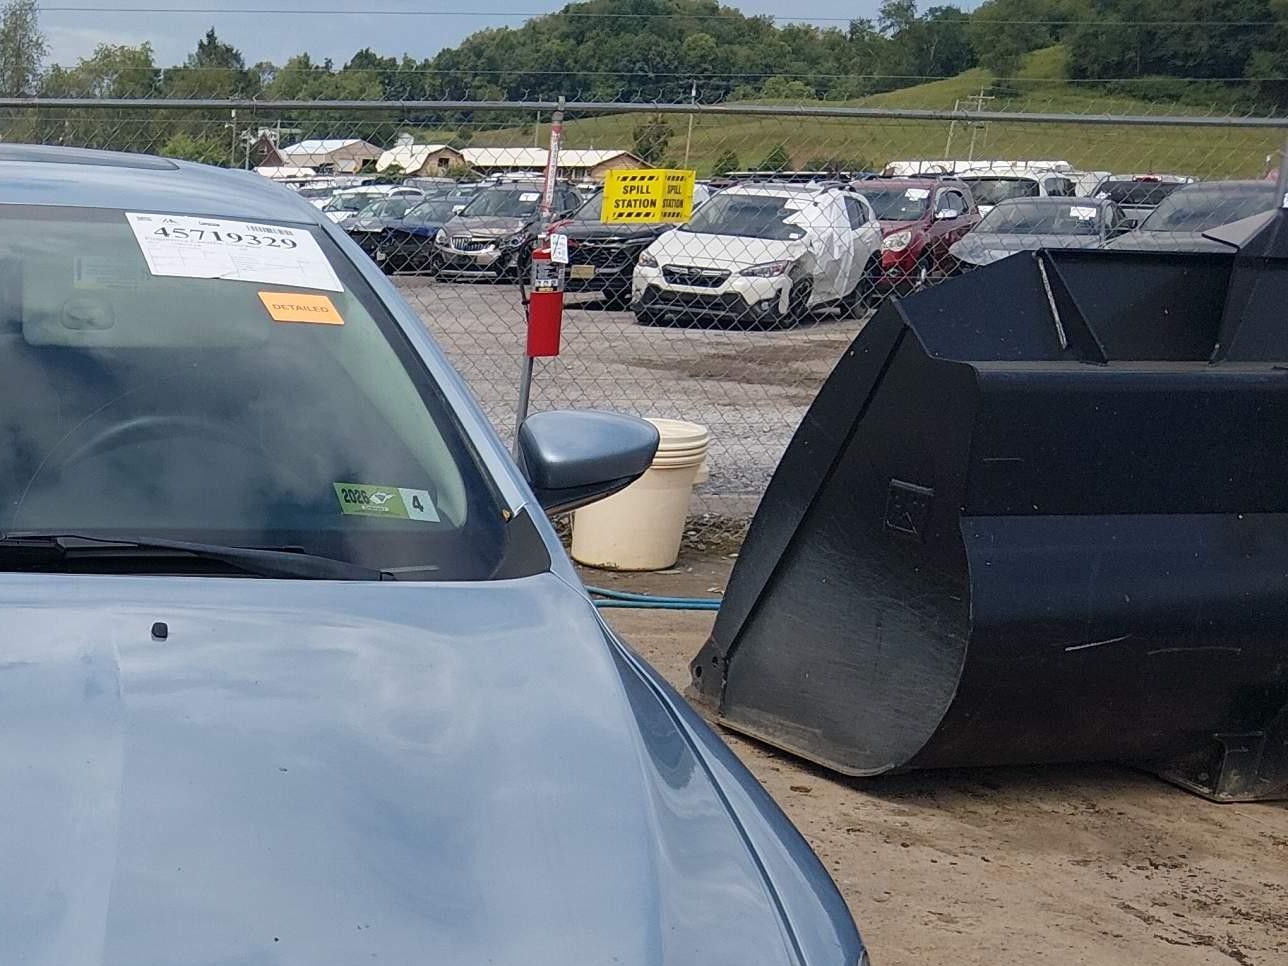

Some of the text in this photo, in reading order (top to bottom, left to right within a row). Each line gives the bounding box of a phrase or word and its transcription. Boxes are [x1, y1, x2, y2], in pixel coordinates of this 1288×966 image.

[622, 185, 651, 194] SPILL
[667, 185, 681, 194] SPILL
[614, 198, 657, 208] STATION
[662, 199, 683, 208] STATION
[153, 226, 298, 250] 45719329
[271, 303, 329, 313] DETAILED
[412, 495, 424, 512] 4
